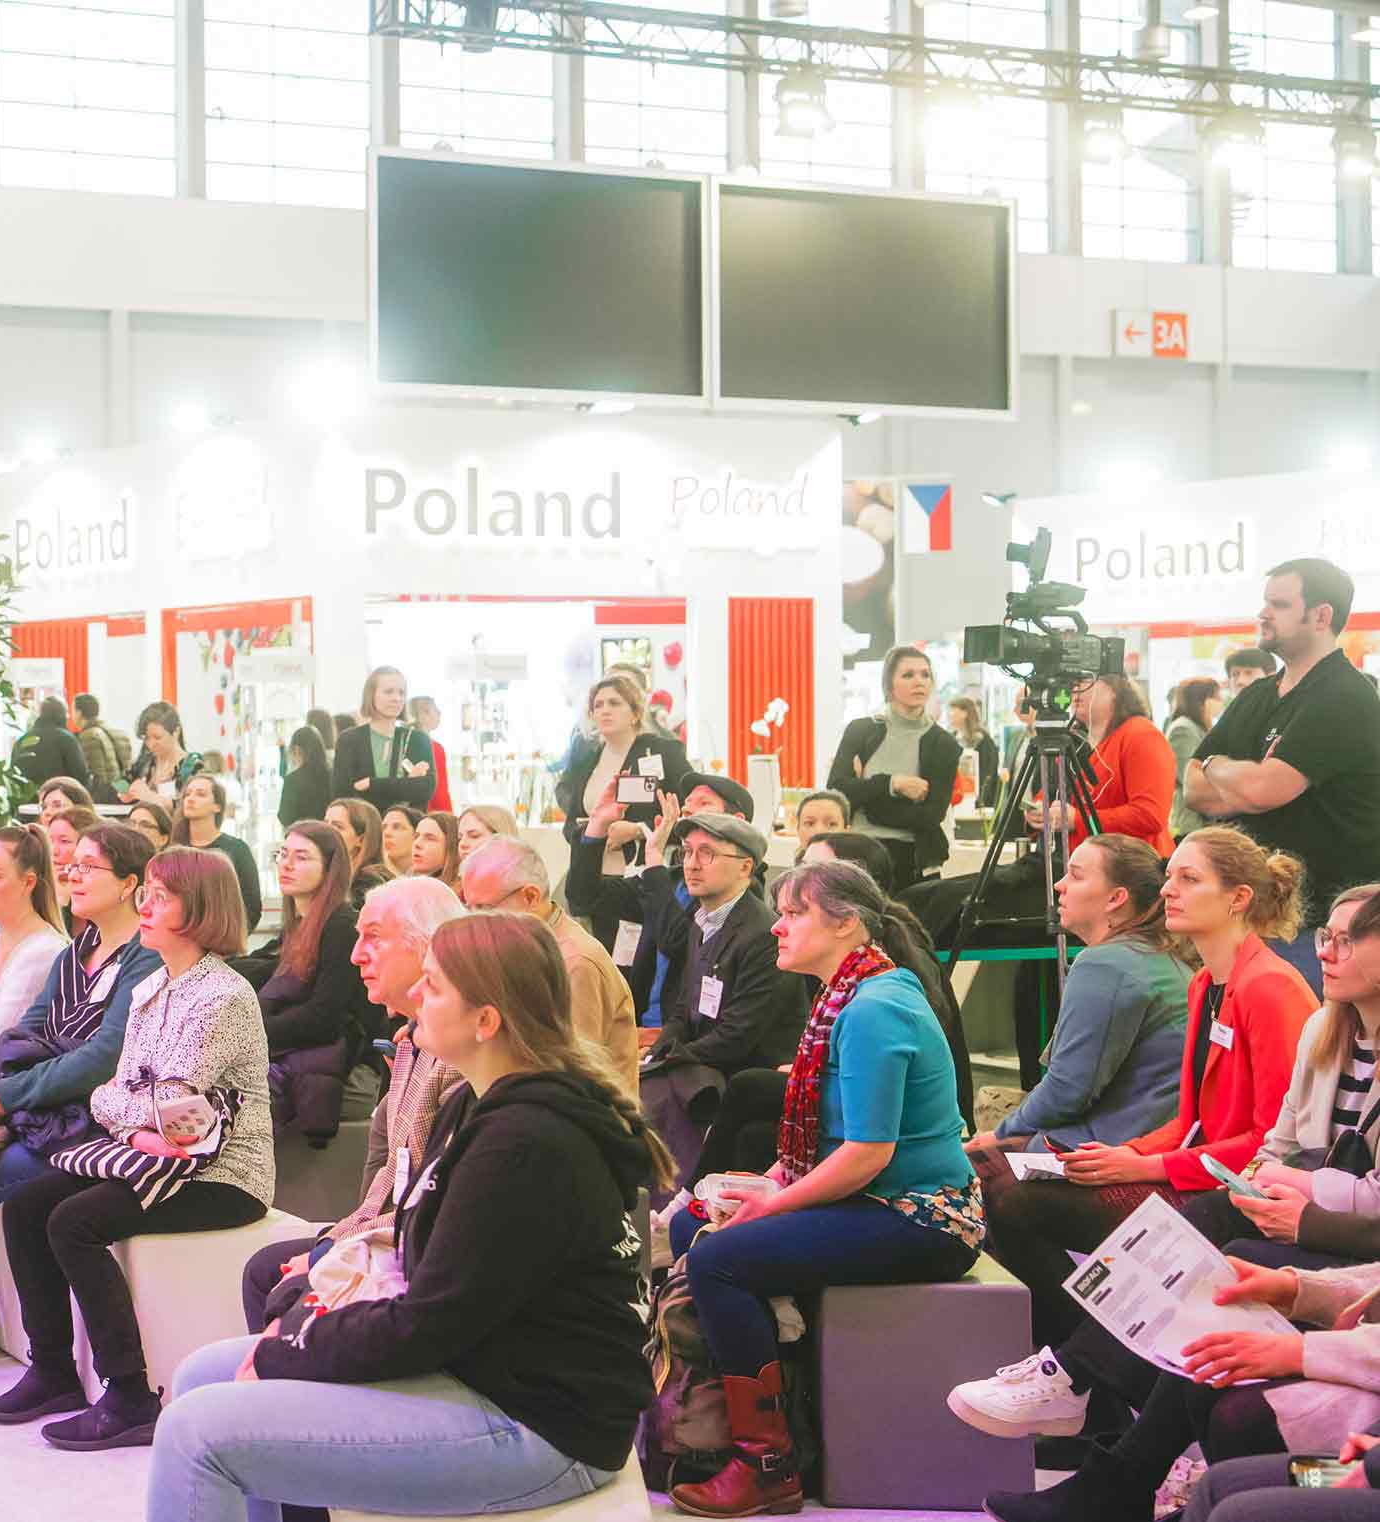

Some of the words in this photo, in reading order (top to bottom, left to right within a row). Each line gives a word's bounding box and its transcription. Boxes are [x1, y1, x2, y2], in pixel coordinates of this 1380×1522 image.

[1155, 320, 1186, 352] 3A
[364, 466, 621, 539] Poland
[671, 471, 809, 516] Poland
[15, 499, 128, 571] Poland
[1075, 521, 1245, 582] Poland
